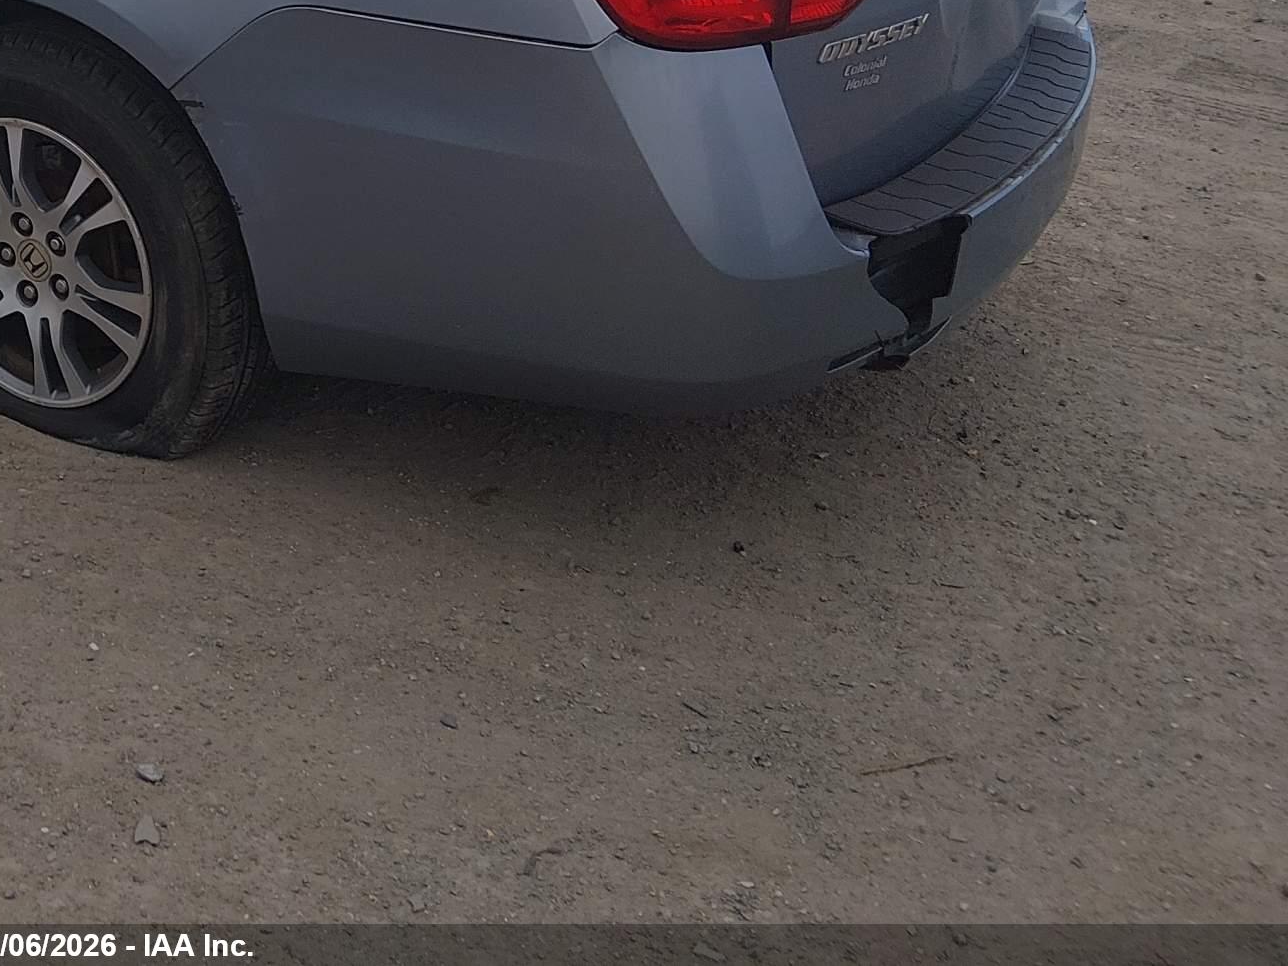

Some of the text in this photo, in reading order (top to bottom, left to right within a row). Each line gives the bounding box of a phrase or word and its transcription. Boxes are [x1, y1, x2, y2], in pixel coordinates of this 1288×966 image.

[817, 13, 930, 64] ODYSSEY
[843, 56, 887, 77] Colonial
[845, 74, 880, 91] Honda
